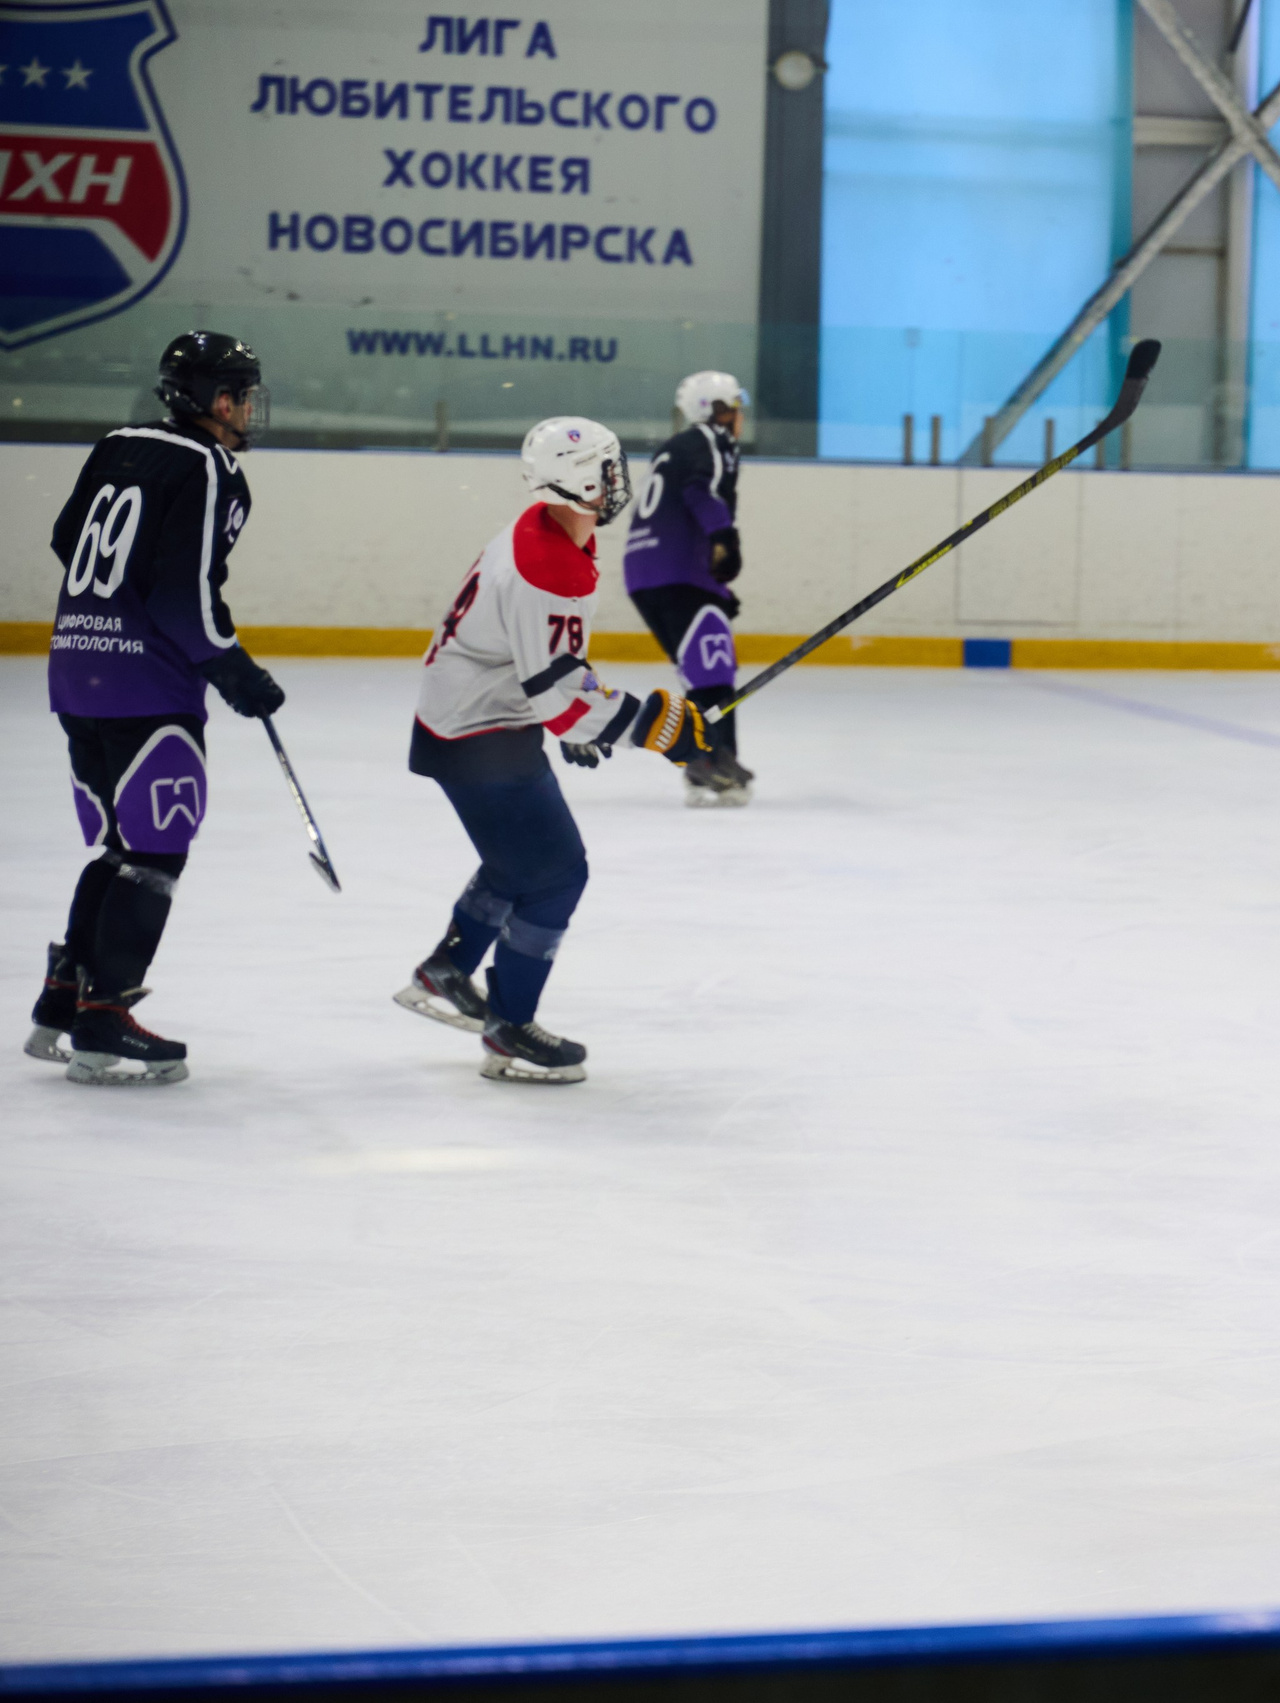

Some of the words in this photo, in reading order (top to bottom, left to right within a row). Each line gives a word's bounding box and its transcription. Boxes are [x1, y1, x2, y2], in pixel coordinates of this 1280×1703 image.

[418, 15, 557, 59] ЛИГА
[250, 73, 717, 134] ЛЮБИТЕЛЬСКОГО
[0, 150, 133, 205] ХН
[382, 147, 591, 195] ХОККЕЯ
[267, 211, 694, 267] НОВОСИБИРСКА
[347, 327, 618, 363] WWW.LLHN.RU
[67, 483, 142, 599] 69
[548, 614, 585, 655] 78
